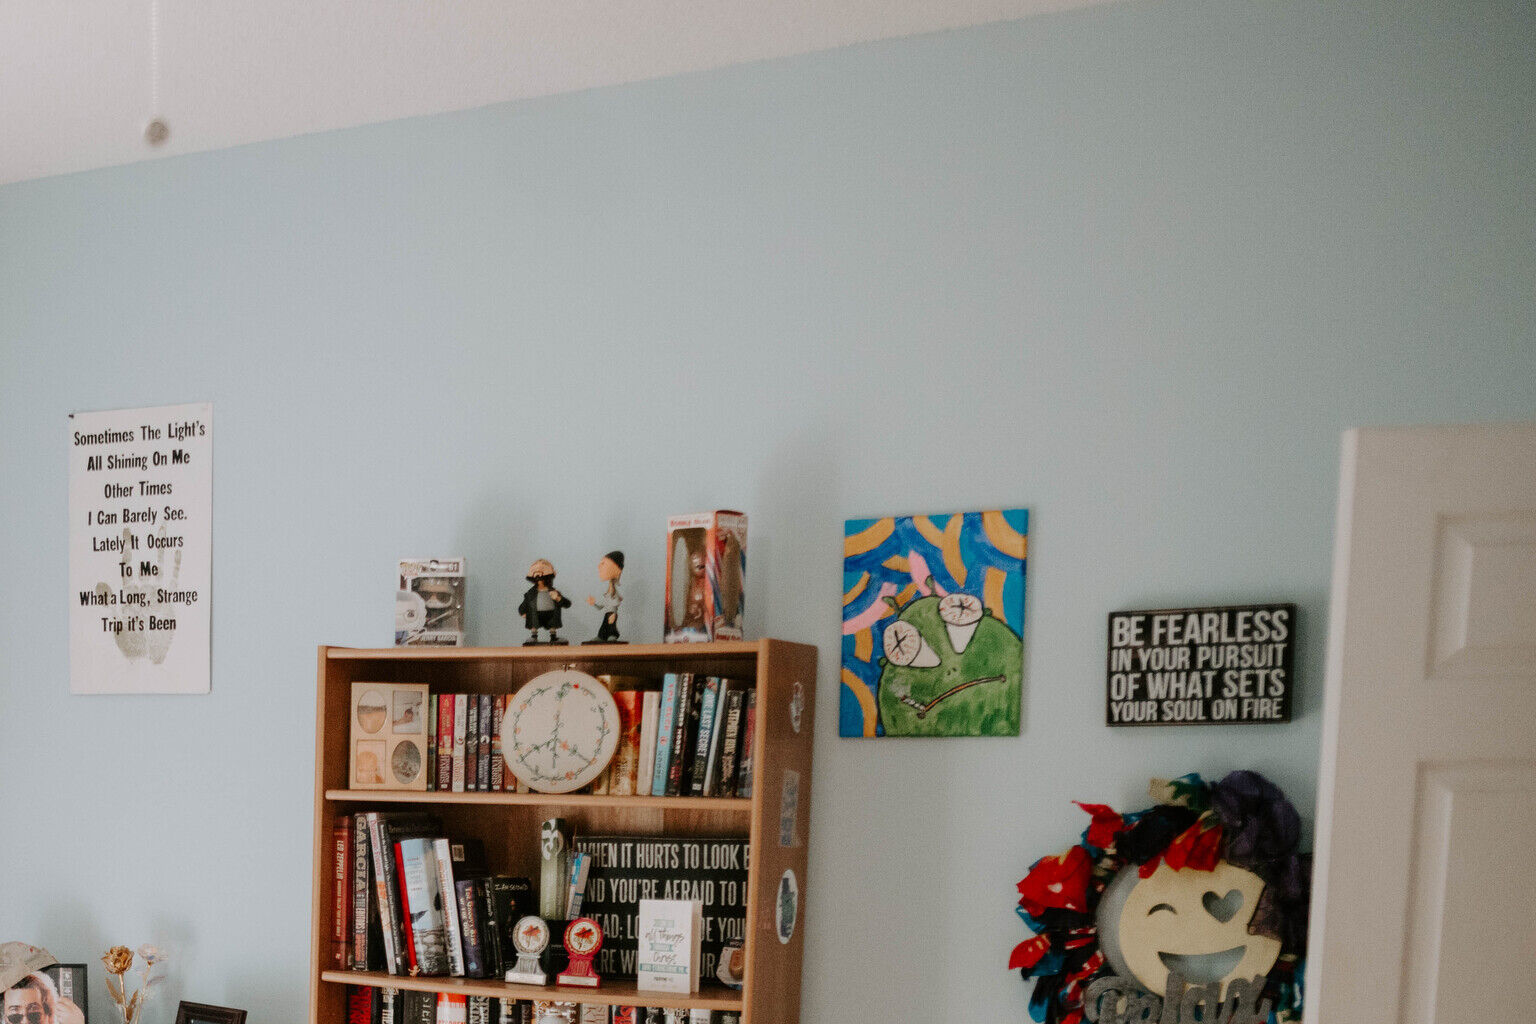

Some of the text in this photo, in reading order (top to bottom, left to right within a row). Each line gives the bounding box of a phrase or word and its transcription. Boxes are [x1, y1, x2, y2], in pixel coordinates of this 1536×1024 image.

[74, 421, 206, 446] Sometimes The Light's
[87, 450, 190, 471] All Shining On Me
[104, 481, 172, 499] Other Times
[88, 507, 188, 526] I Can Barely See.
[92, 534, 184, 554] Lately It Occurs
[119, 562, 159, 577] To Me
[79, 589, 198, 607] What a Long, Strange
[101, 616, 177, 635] Trip it's Been
[1112, 610, 1289, 647] BE FEARLESS
[1111, 644, 1287, 672] IN YOUR PURSUIT
[1111, 668, 1285, 700] OF WHAT SETS
[700, 710, 713, 729] LAST
[1110, 698, 1283, 722] YOUR SOUL ON FIRE
[697, 730, 711, 758] SECRET
[355, 816, 367, 892] GARCIA
[621, 843, 632, 868] IT
[636, 843, 680, 869] HURTS
[683, 845, 699, 869] TO
[703, 846, 739, 870] LOOK
[585, 878, 738, 906] ND YOU'RE AFRAID TO
